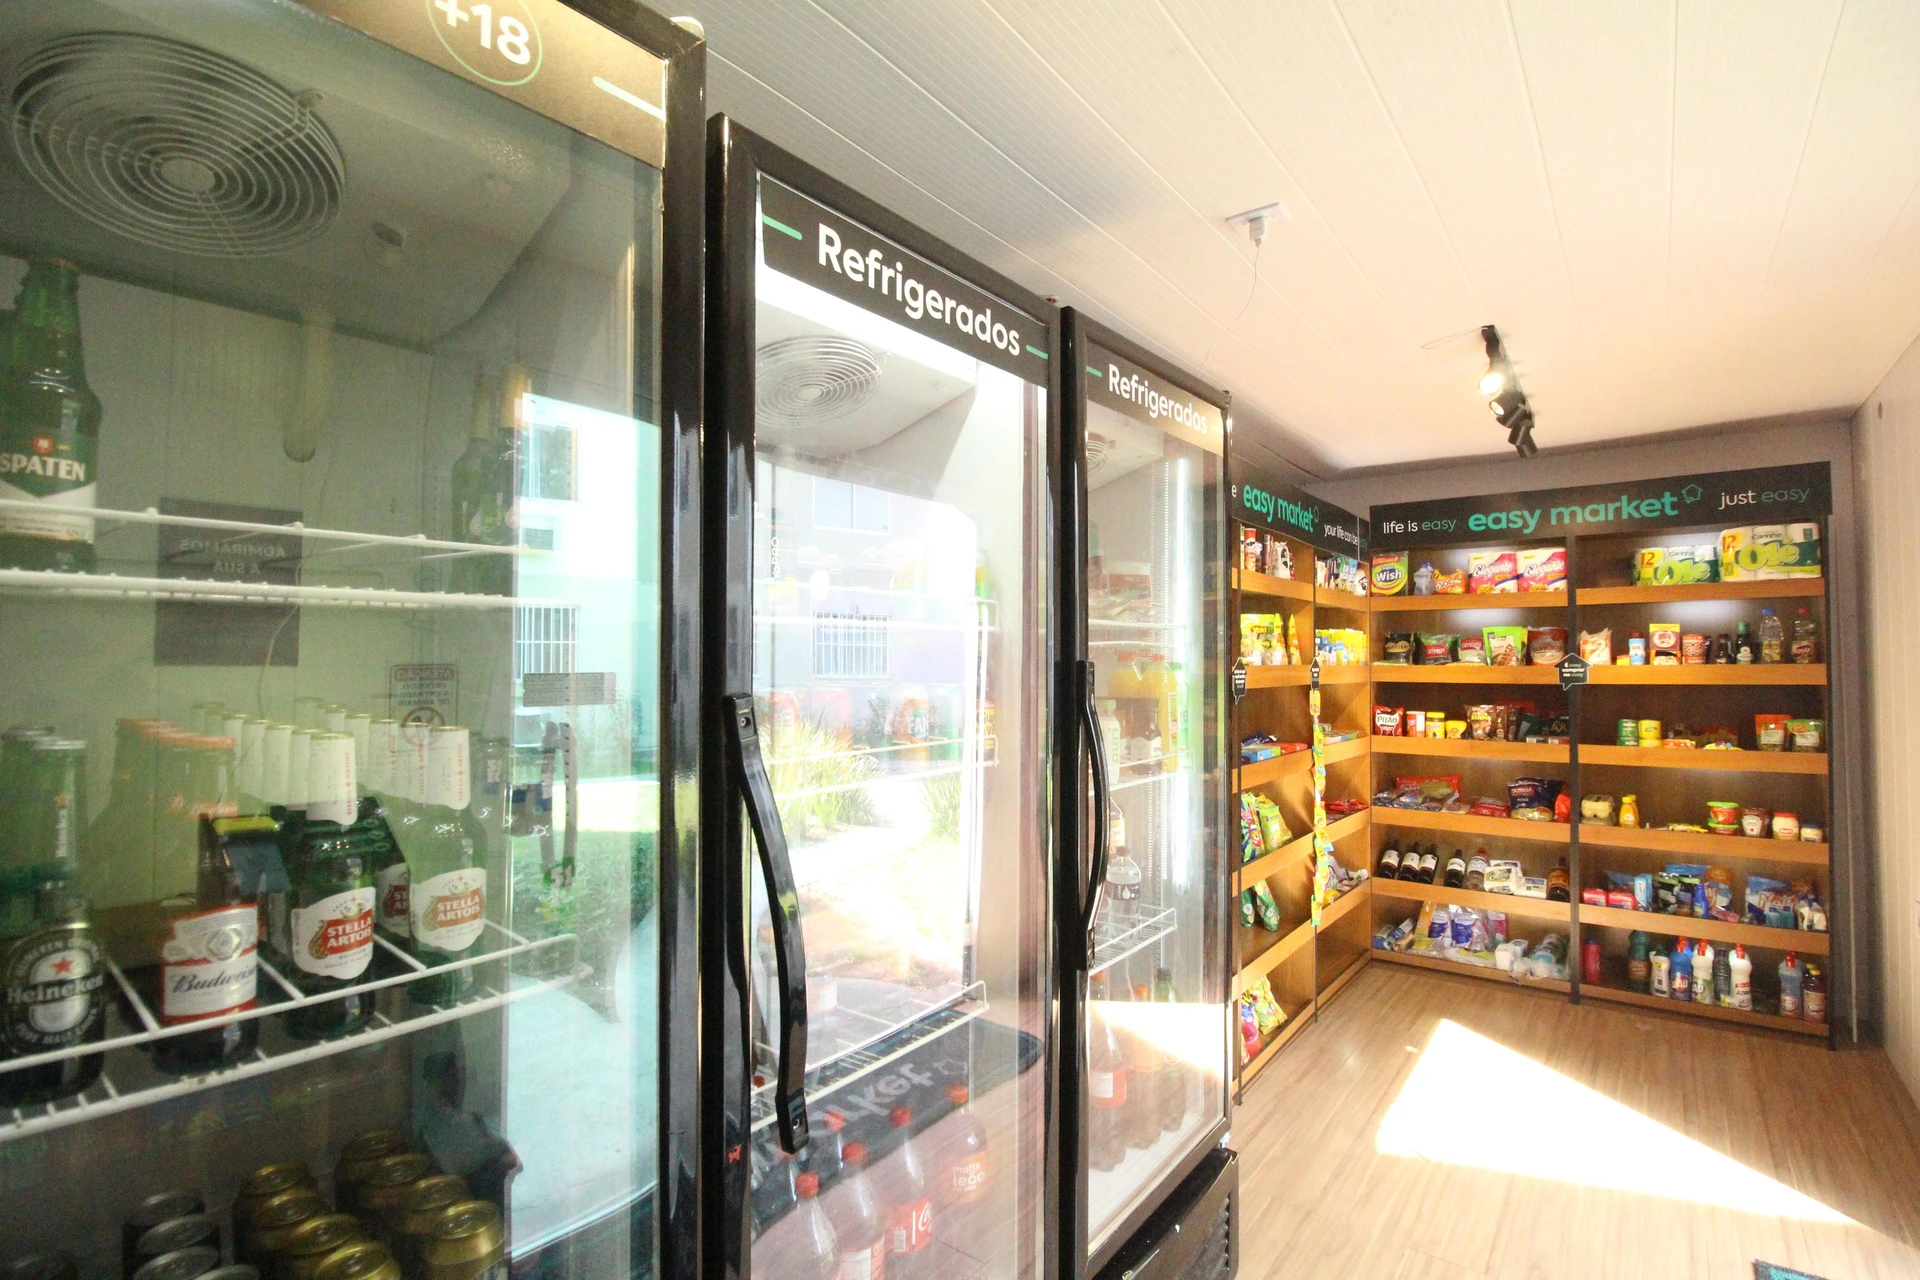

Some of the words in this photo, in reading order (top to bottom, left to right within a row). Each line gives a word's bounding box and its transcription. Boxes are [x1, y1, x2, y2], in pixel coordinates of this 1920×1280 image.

[434, 0, 531, 65] +18
[818, 222, 1021, 357] Refrigerados
[1108, 363, 1208, 435] Refrigerados
[0, 453, 86, 482] SPATEN
[1243, 484, 1276, 523] easy
[1277, 498, 1314, 533] market
[1718, 490, 1757, 510] just
[1761, 487, 1810, 503] easy
[1468, 508, 1542, 535] easy
[1550, 491, 1679, 526] market
[1324, 524, 1337, 537] your
[1337, 525, 1345, 540] life
[1383, 520, 1405, 534] life
[1408, 520, 1418, 533] is
[1421, 519, 1457, 532] easy
[1722, 535, 1737, 551] 12
[1738, 536, 1799, 571] Olé
[1641, 552, 1655, 568] 12
[1376, 568, 1402, 582] Wish
[436, 904, 481, 922] ARTOIS
[437, 894, 481, 911] STELLA
[327, 917, 372, 938] STELLA
[327, 929, 373, 949] ARTOIS
